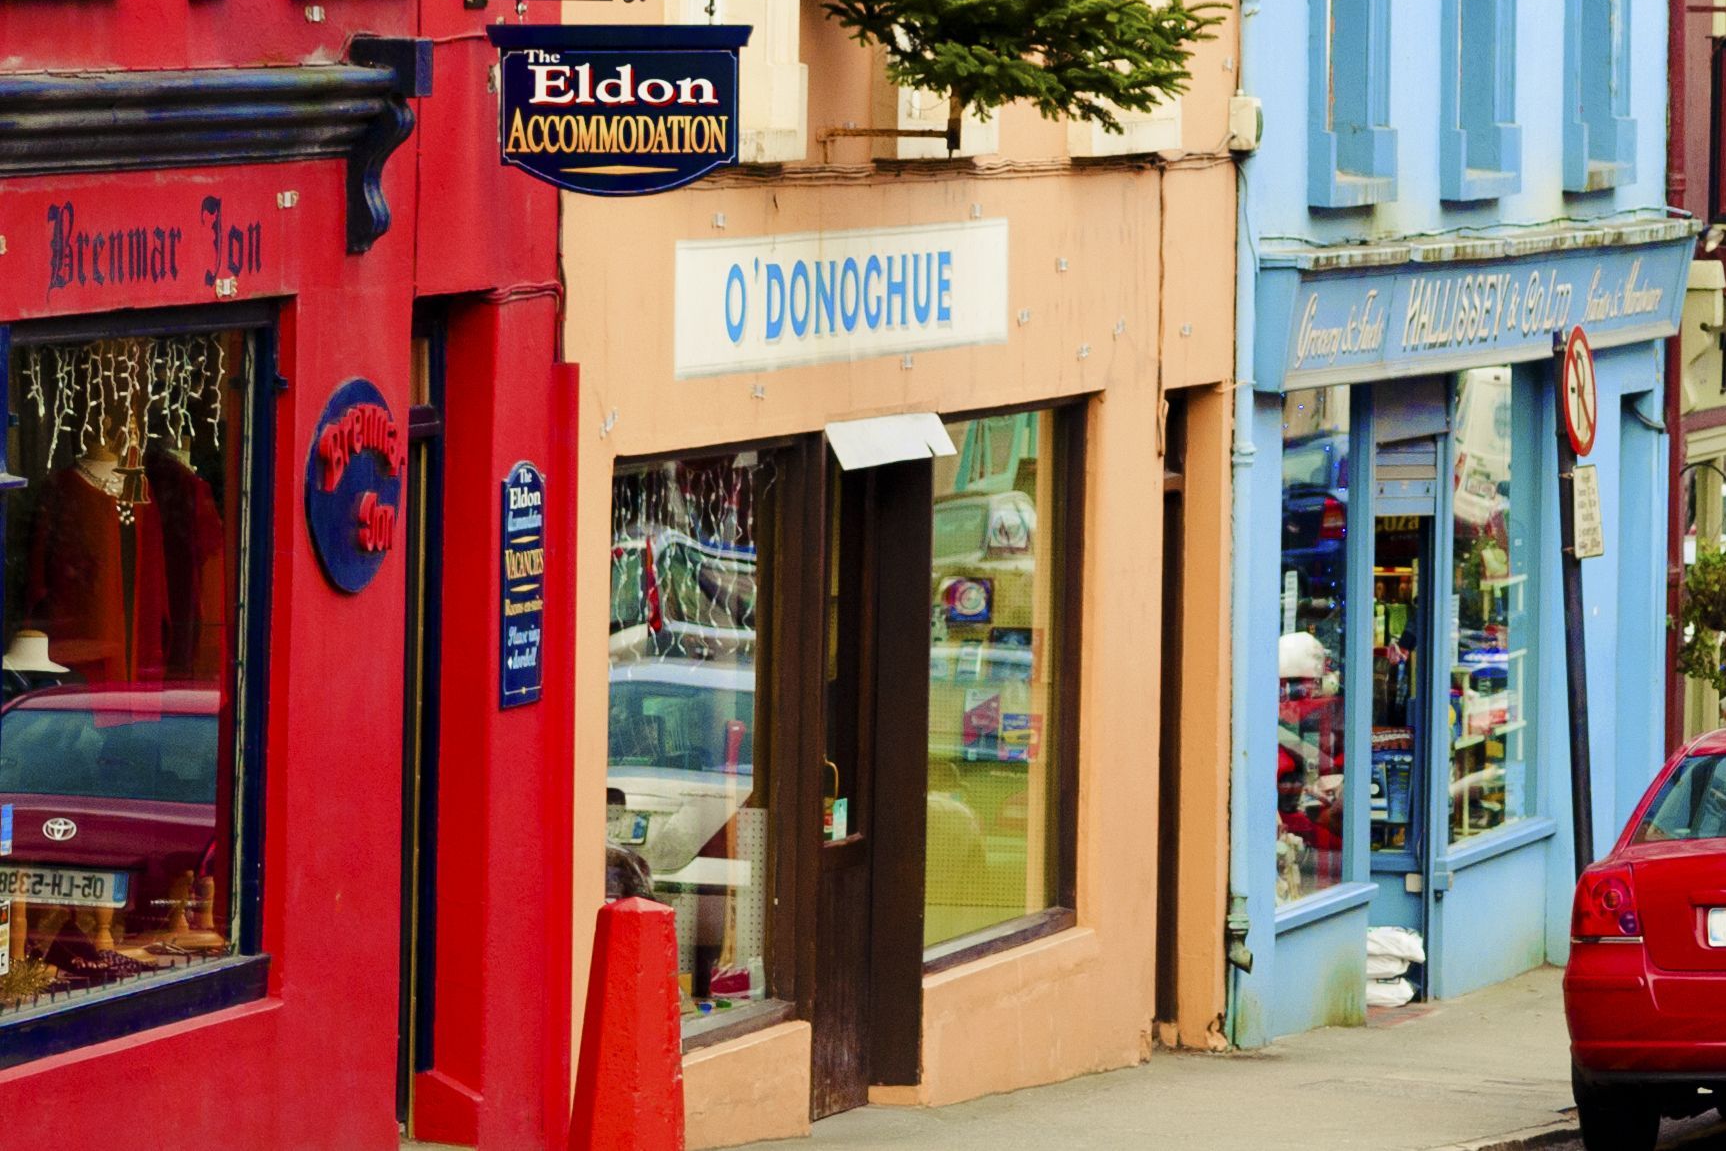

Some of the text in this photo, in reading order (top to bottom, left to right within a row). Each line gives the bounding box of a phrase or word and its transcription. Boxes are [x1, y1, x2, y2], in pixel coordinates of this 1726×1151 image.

[524, 49, 560, 64] The
[527, 62, 720, 107] Eldon
[505, 107, 728, 153] ACCOMMODATION
[47, 196, 262, 302] Brenmar Jon
[725, 250, 951, 344] O'DONOGHUE
[1402, 273, 1510, 348] HALLISSEY
[1507, 282, 1520, 329] &
[319, 404, 406, 492] Brenma
[509, 489, 542, 510] Eldon
[519, 468, 532, 485] The
